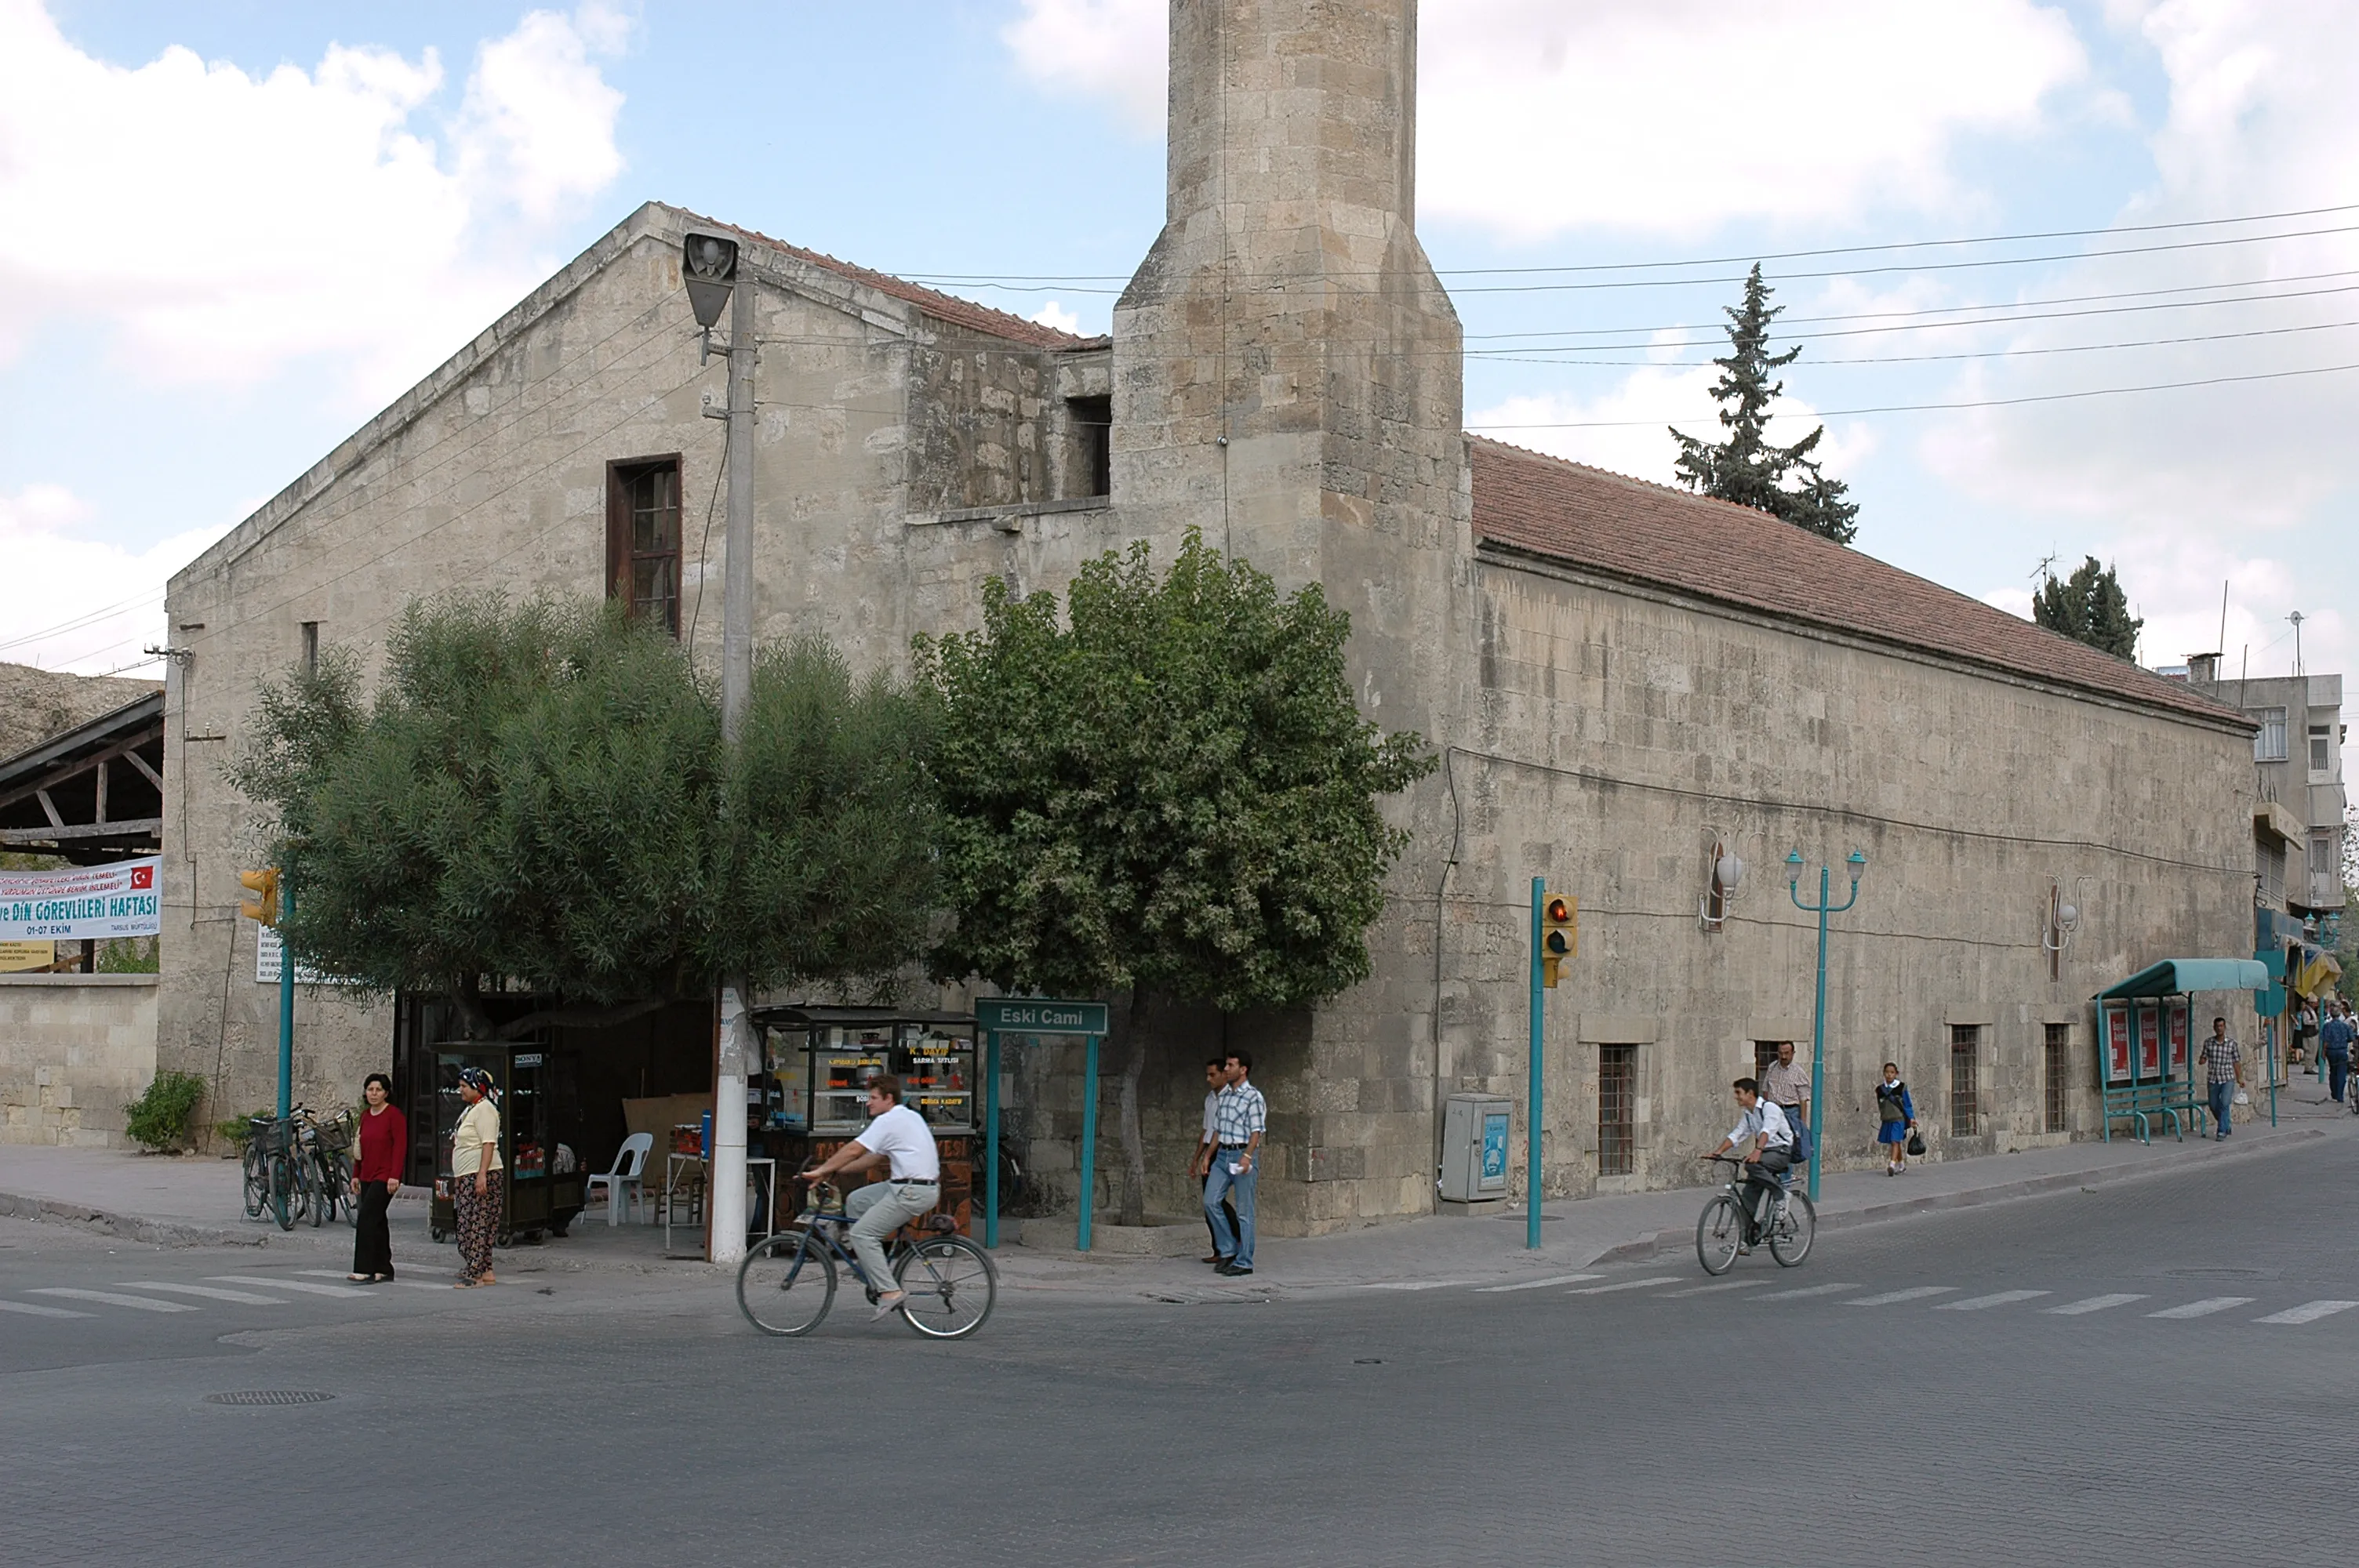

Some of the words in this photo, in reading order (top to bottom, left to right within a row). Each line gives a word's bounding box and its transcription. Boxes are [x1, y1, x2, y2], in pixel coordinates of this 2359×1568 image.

[13, 900, 32, 921] DİN
[36, 896, 106, 920] GÖREVLİLERİ
[110, 895, 158, 916] HAFTASI
[27, 925, 47, 935] 01-07
[50, 923, 71, 934] EKİM
[1001, 1008, 1036, 1023] Eski
[1041, 1009, 1083, 1025] Cami
